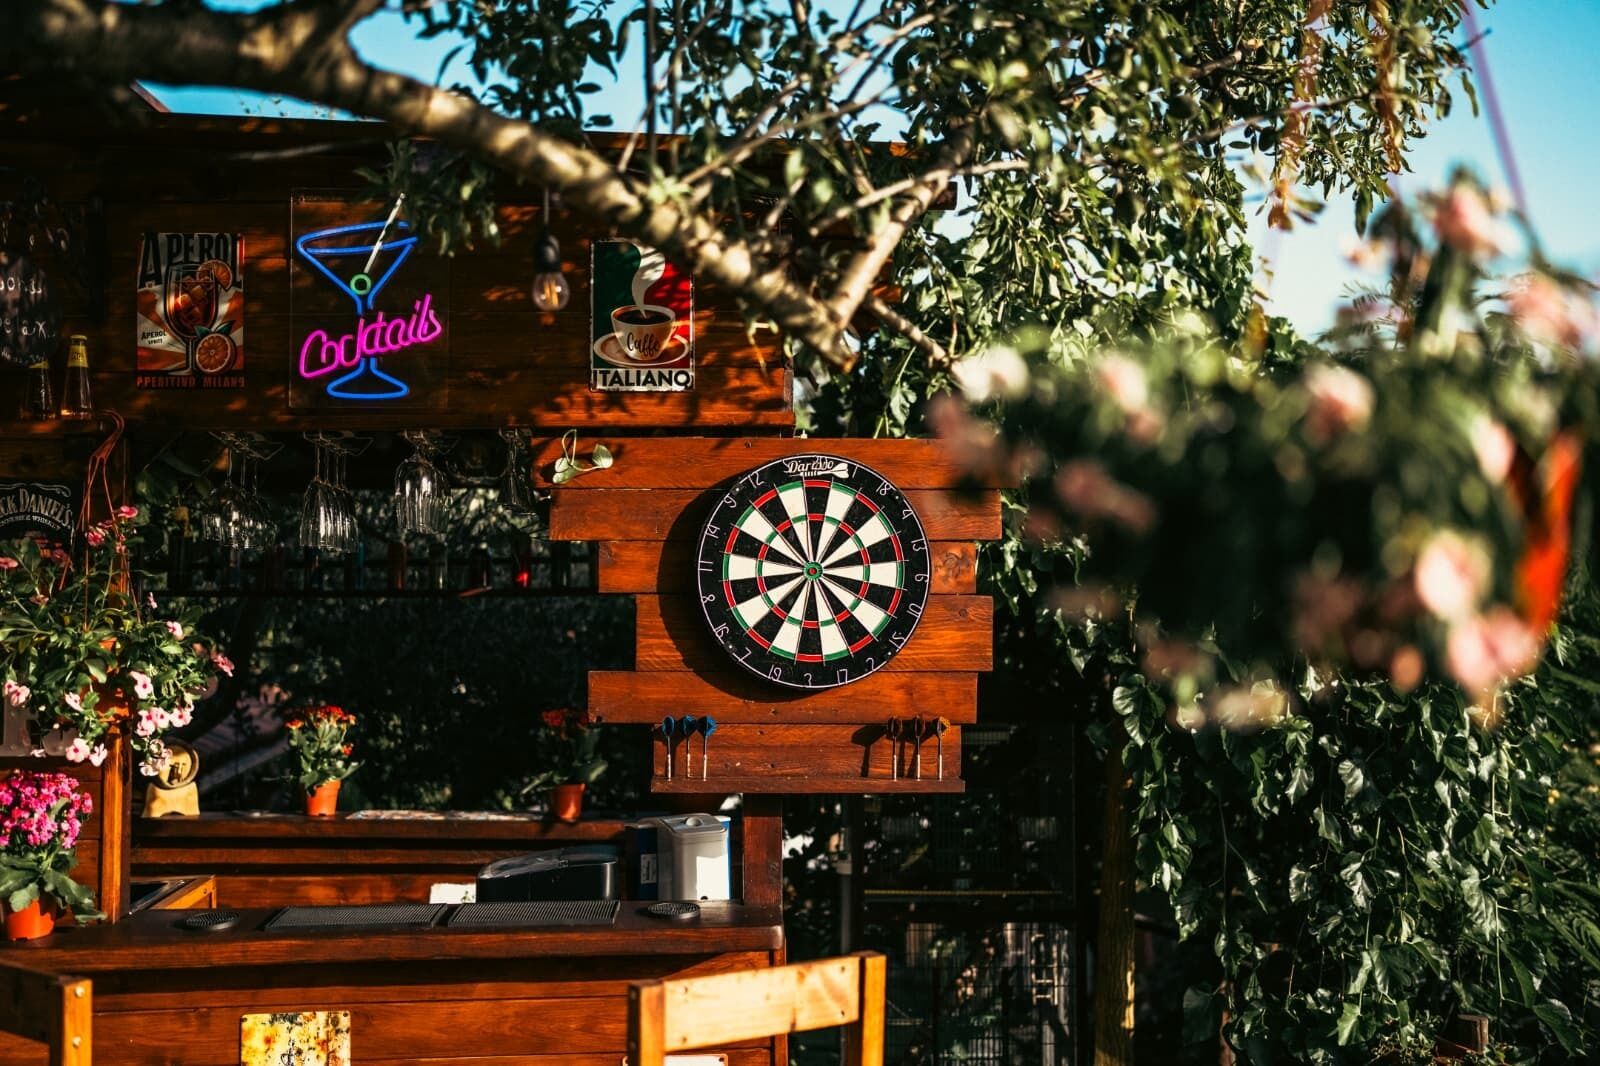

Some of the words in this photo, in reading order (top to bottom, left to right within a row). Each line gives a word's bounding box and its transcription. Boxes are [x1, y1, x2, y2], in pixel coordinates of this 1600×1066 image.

[138, 231, 243, 288] APEROL
[141, 330, 168, 341] APEROL
[299, 293, 442, 378] Cocktails
[592, 369, 693, 389] ITALIANO
[747, 471, 765, 489] 12
[875, 480, 892, 496] 18
[723, 494, 737, 509] 9
[902, 508, 915, 520] 4
[704, 523, 721, 540] 14
[911, 537, 928, 552] 13
[914, 572, 930, 583] 6
[701, 593, 716, 605] 8
[905, 602, 923, 619] 10
[713, 621, 730, 639] 16
[767, 663, 783, 682] 19
[836, 667, 849, 686] 17
